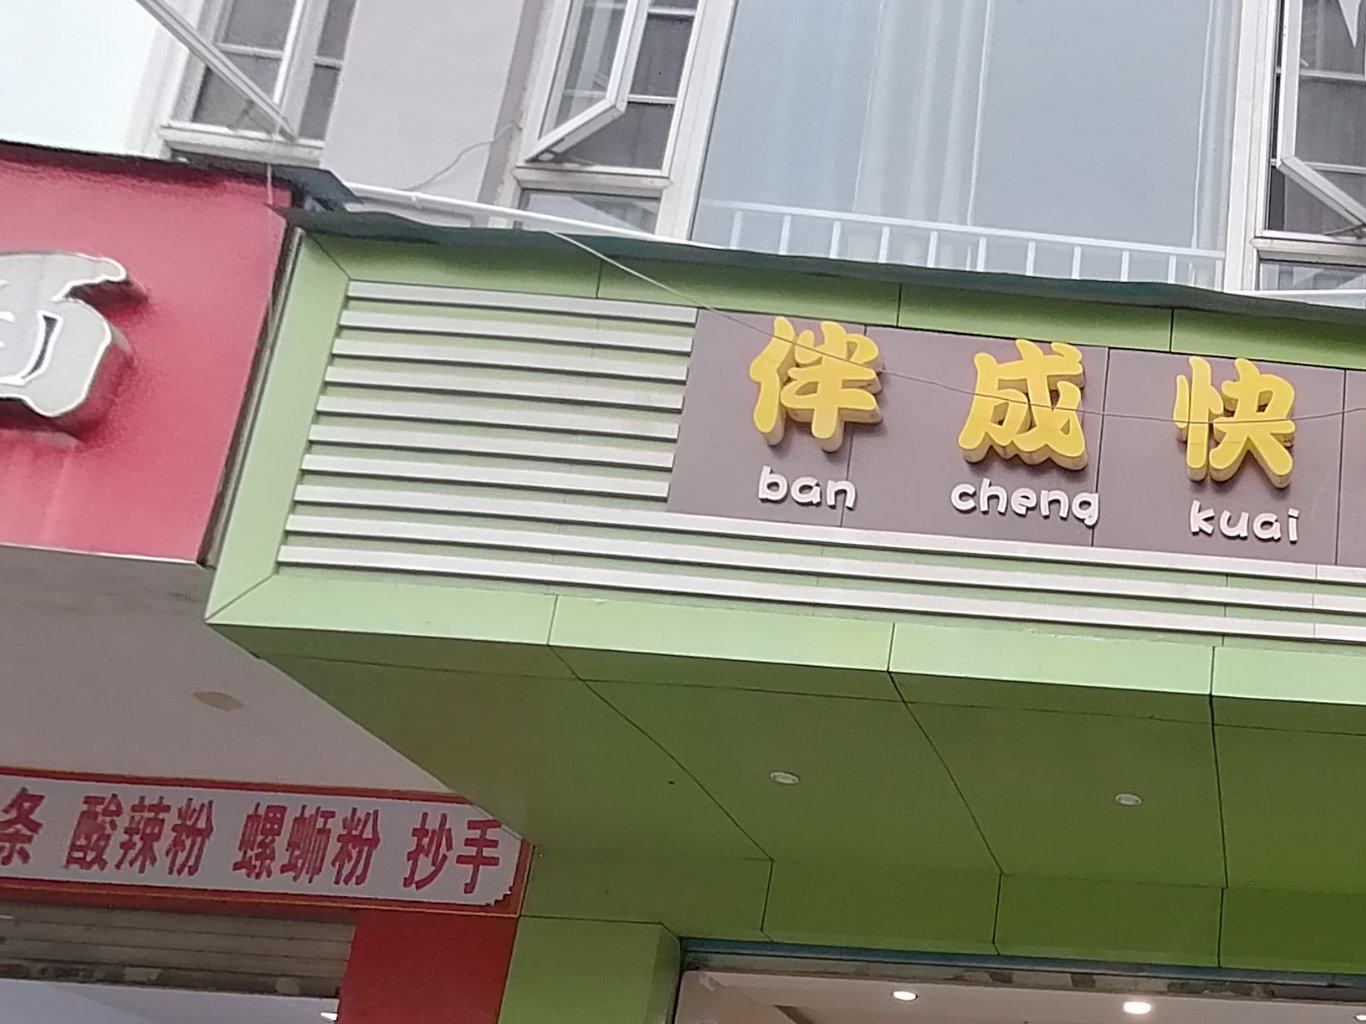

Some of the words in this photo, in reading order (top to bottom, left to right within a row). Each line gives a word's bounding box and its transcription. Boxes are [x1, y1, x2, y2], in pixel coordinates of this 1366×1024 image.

[757, 465, 857, 511] ban
[950, 476, 1100, 527] cheng
[1189, 498, 1300, 545] kuai
[65, 793, 214, 877] 酸辣粉
[232, 802, 381, 887] 螺蛳粉
[403, 812, 502, 894] 抄手
